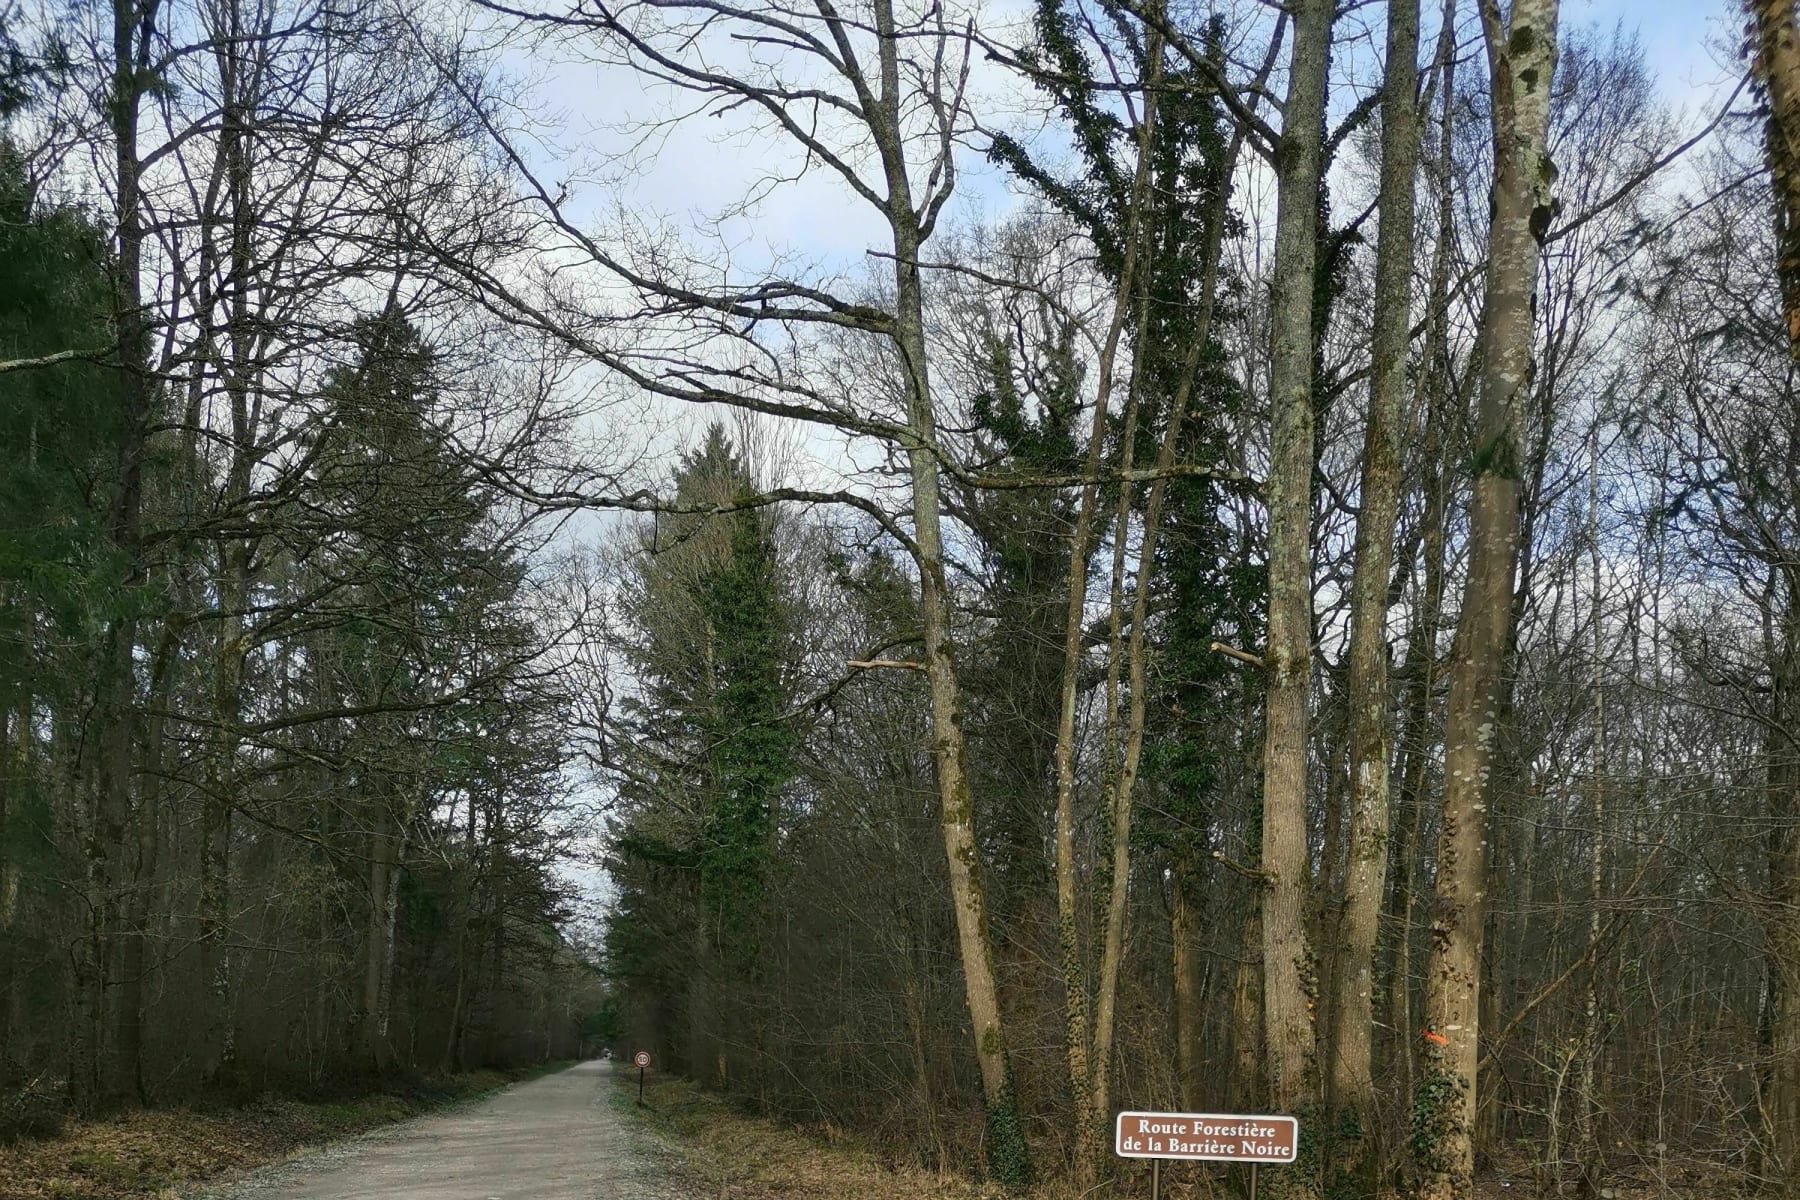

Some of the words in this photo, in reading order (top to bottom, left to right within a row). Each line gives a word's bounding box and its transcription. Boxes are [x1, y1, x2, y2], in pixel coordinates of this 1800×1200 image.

[1138, 1119, 1186, 1135] Route
[1192, 1121, 1276, 1138] Forestière
[1123, 1136, 1142, 1151] de
[1148, 1137, 1162, 1152] la
[1168, 1138, 1236, 1154] Barrière
[1241, 1140, 1290, 1156] Noire
